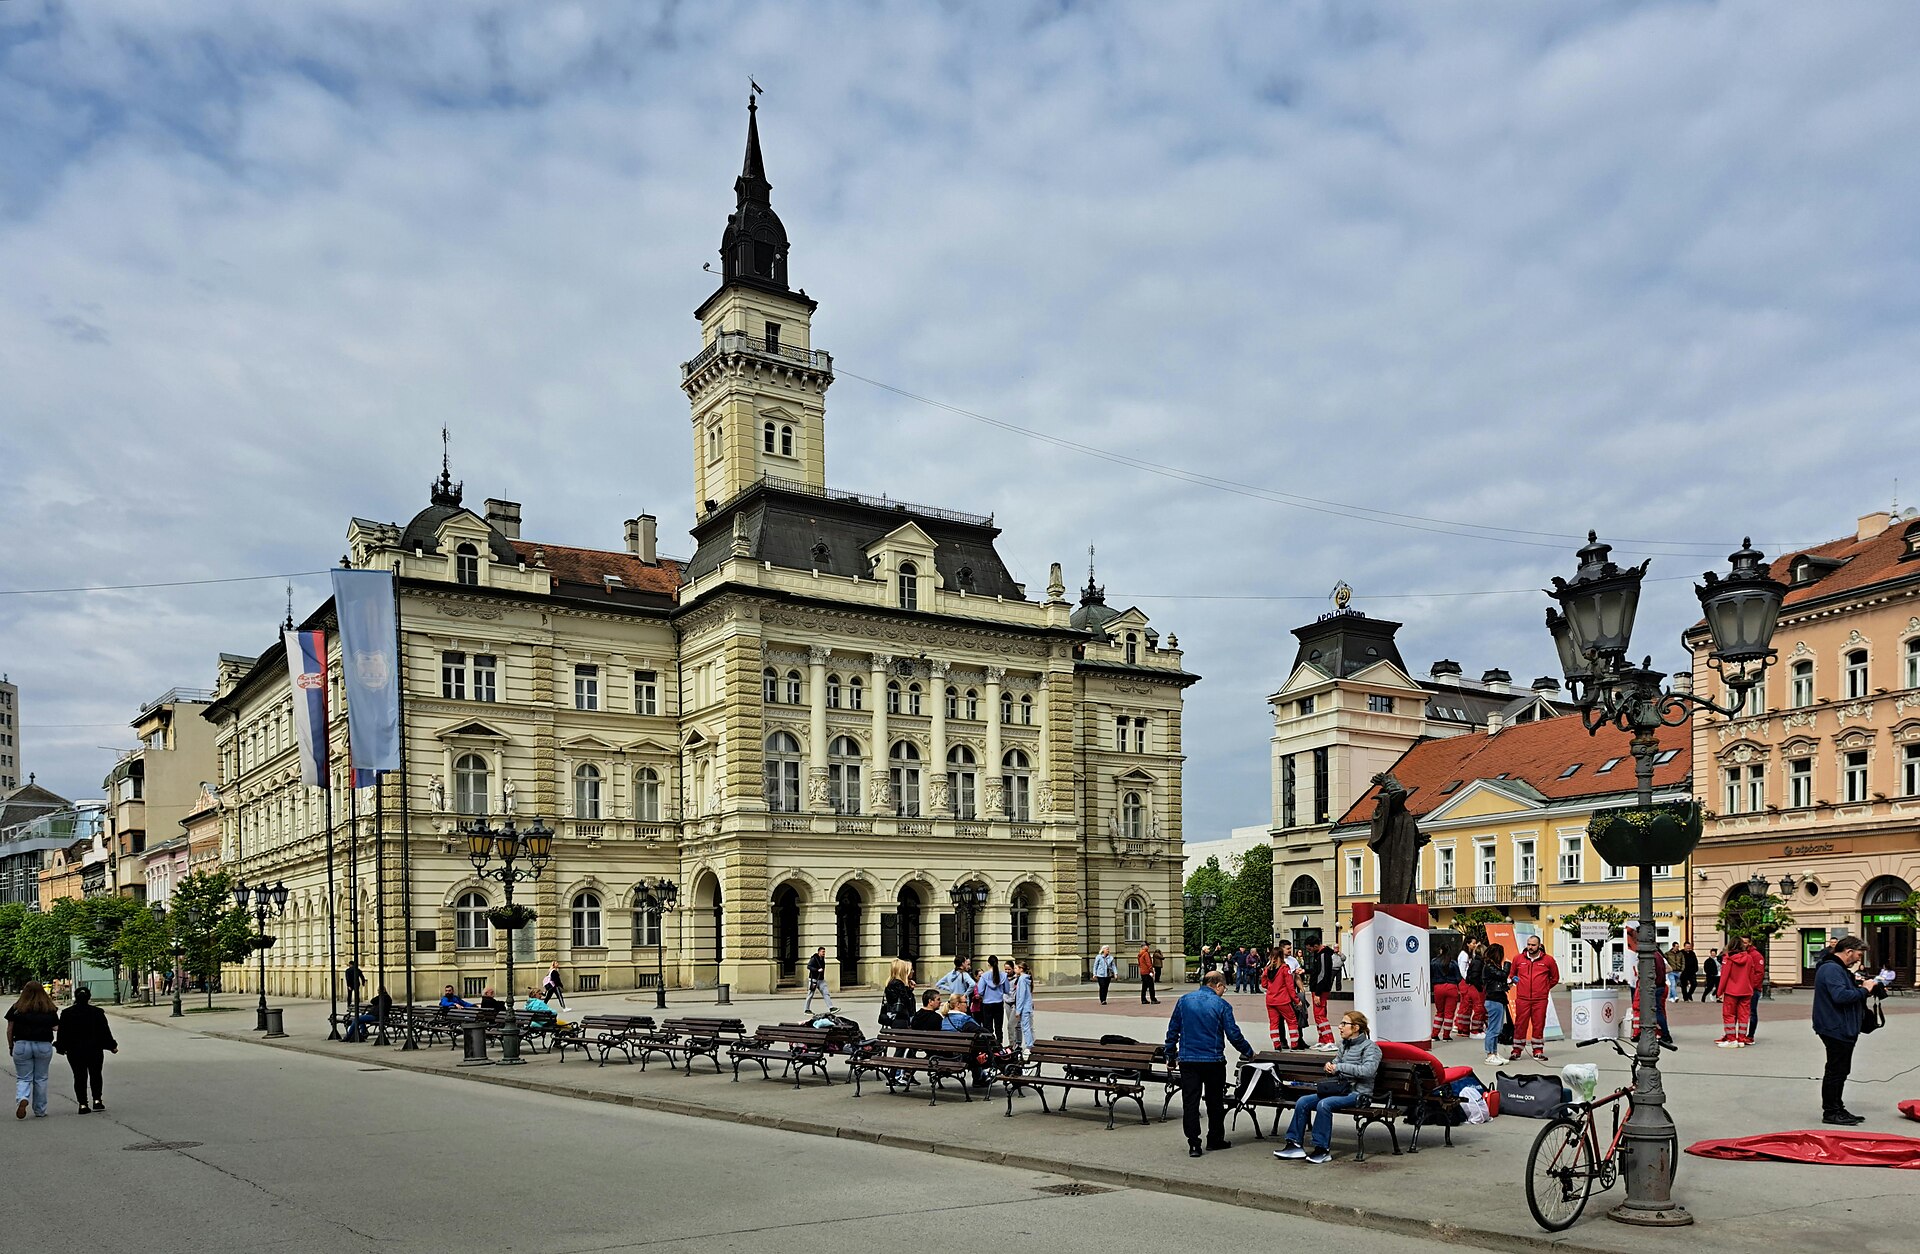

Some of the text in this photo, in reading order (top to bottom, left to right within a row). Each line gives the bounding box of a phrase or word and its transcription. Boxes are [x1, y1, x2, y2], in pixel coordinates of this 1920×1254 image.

[1317, 610, 1340, 623] APOLO
[1375, 973, 1411, 990] ASI ME
